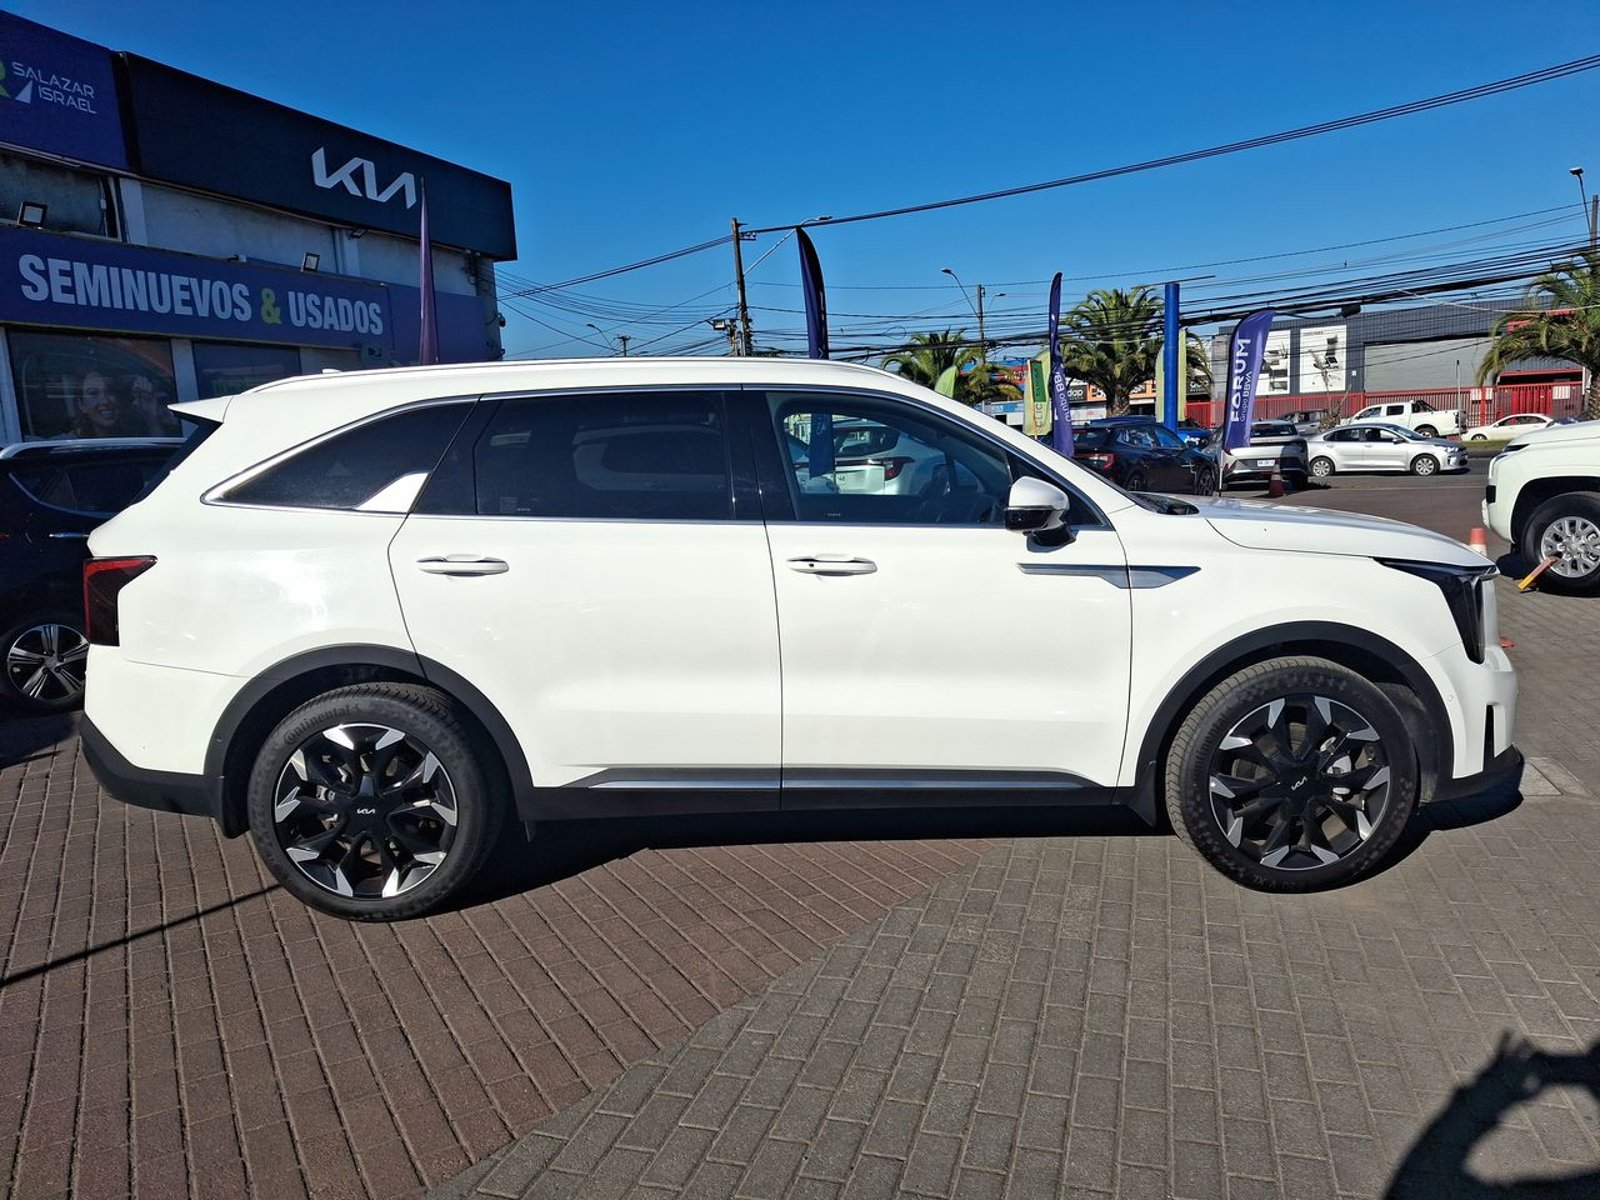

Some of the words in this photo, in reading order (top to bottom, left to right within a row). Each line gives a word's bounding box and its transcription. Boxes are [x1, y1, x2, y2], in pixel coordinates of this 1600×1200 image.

[12, 61, 95, 99] SALAZAR
[38, 85, 98, 114] ISRAEL
[311, 146, 417, 209] KIA
[19, 254, 251, 322] SEMINUEVOS
[260, 287, 282, 325] &
[287, 290, 383, 336] USADOS
[1231, 339, 1251, 422] FORUM
[1243, 371, 1252, 396] BBVA
